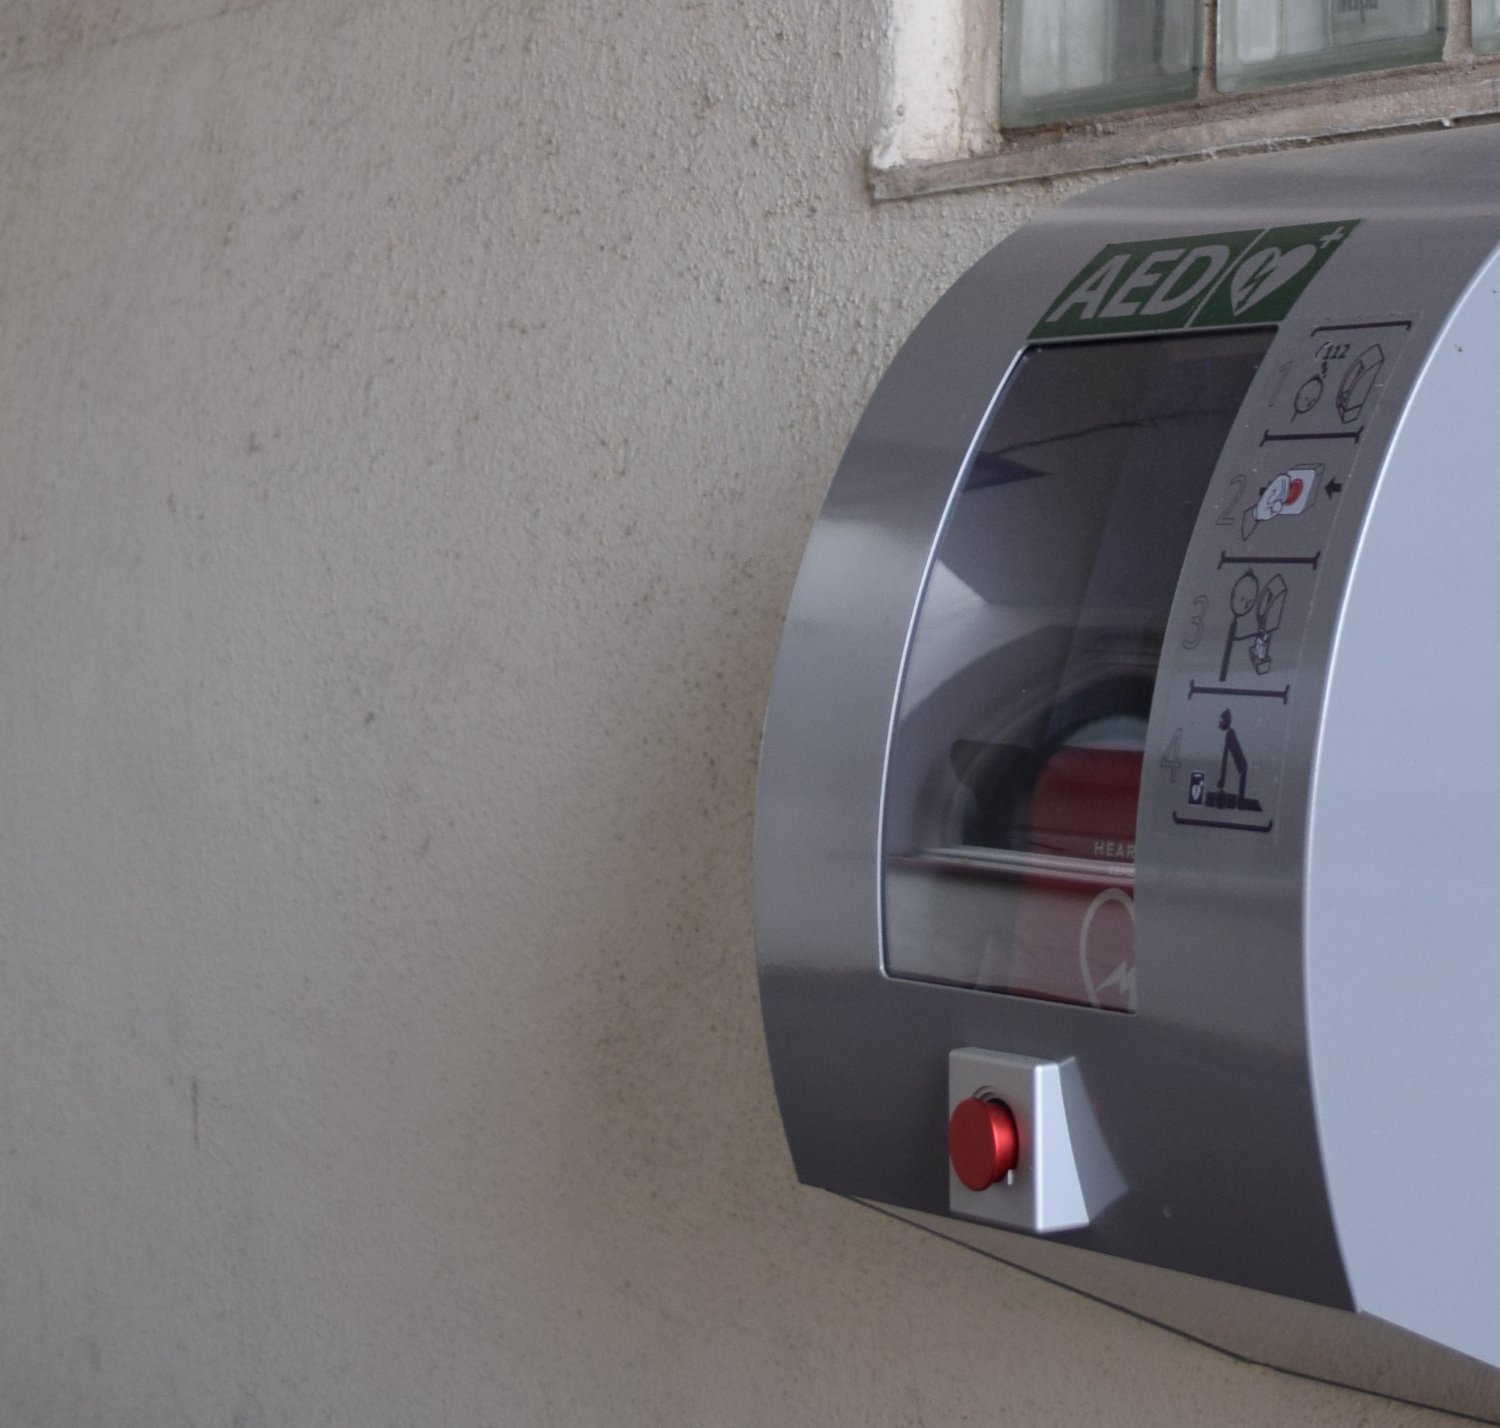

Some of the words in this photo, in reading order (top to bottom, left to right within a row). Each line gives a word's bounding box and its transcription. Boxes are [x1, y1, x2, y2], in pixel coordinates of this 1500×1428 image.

[1047, 243, 1227, 322] AED
[1324, 344, 1350, 360] 112
[1214, 475, 1247, 526] 2
[1182, 595, 1210, 650] 3
[1159, 728, 1187, 783] 4
